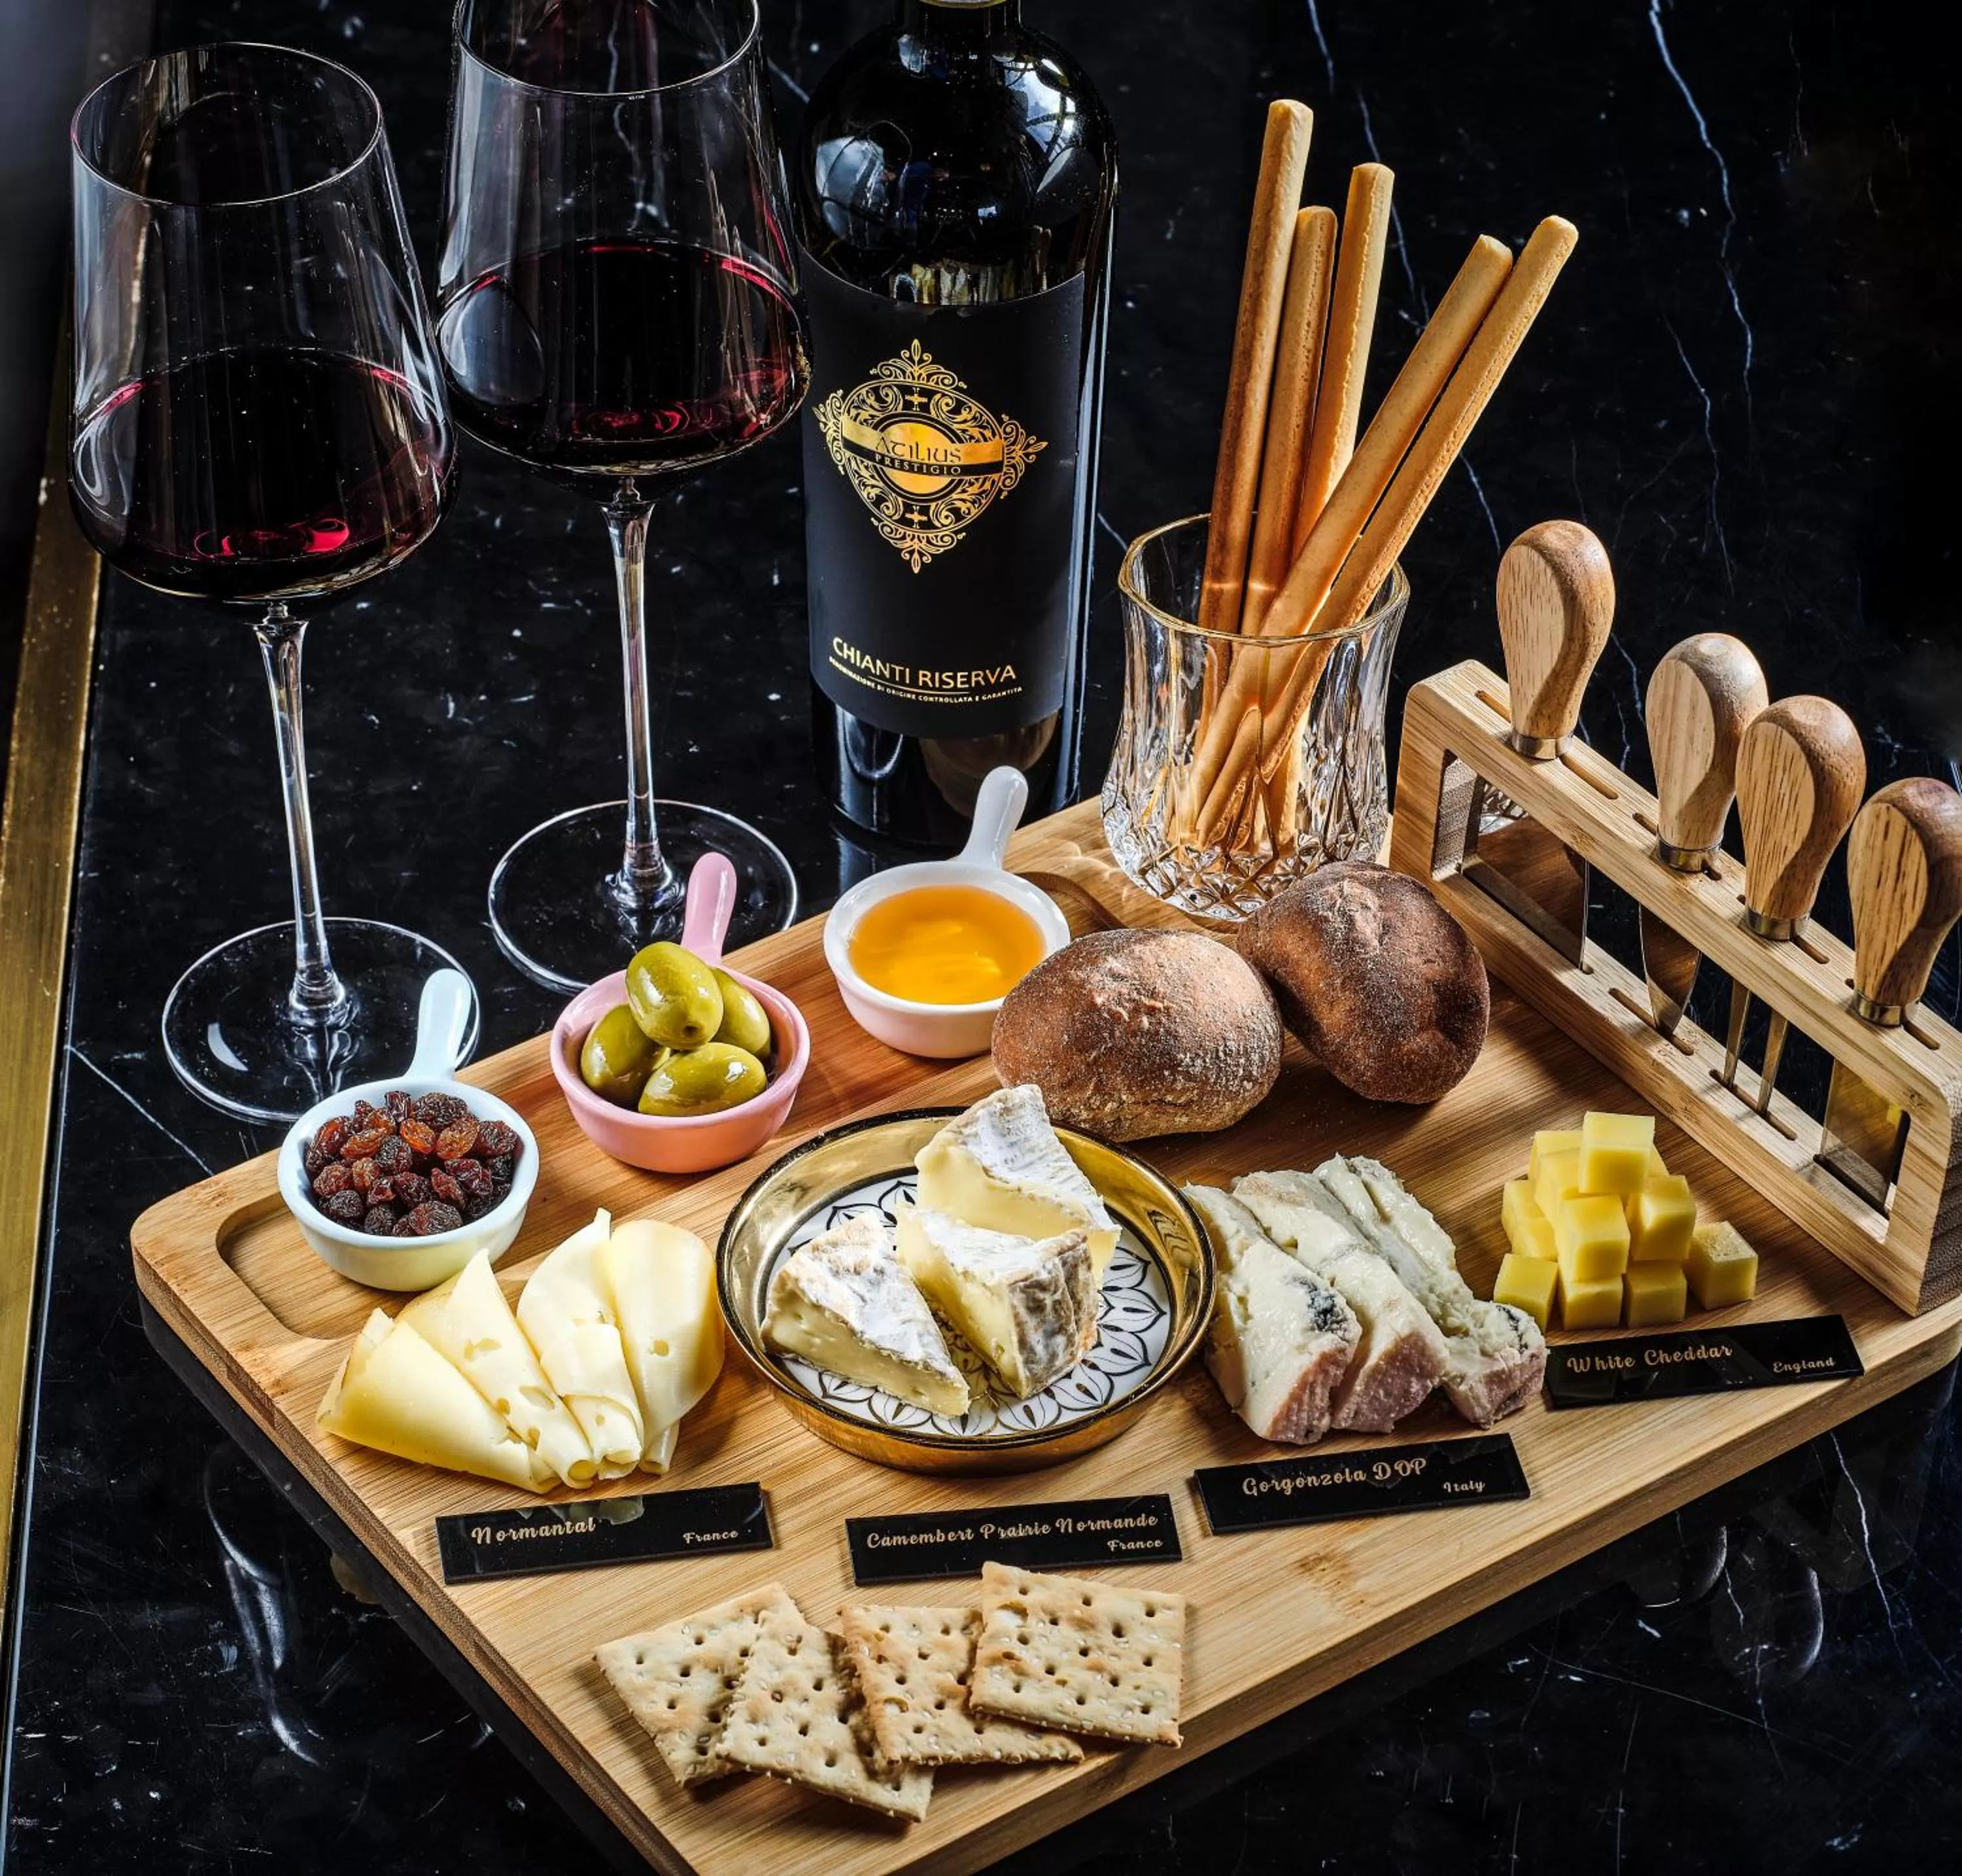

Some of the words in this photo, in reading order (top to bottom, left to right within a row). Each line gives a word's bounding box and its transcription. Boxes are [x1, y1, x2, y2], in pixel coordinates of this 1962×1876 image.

[875, 453, 961, 474] PRESTIGIO
[832, 636, 910, 684] CHIANTI
[918, 665, 1016, 689] RISERVA
[918, 694, 973, 704] CONTROLLATA
[982, 686, 1023, 701] GARANTITA
[1566, 1351, 1636, 1374] White
[1644, 1345, 1733, 1367] Cheddar
[1773, 1357, 1836, 1374] England
[1242, 1468, 1367, 1496] Gorgonzola
[1373, 1457, 1428, 1481] DOP
[1443, 1480, 1486, 1494] Italy
[471, 1517, 596, 1545] Normantal
[683, 1530, 739, 1544] France
[867, 1529, 975, 1549] Camembert
[980, 1522, 1052, 1539] Prairie
[1055, 1513, 1159, 1533] Normande
[1107, 1538, 1163, 1552] France
